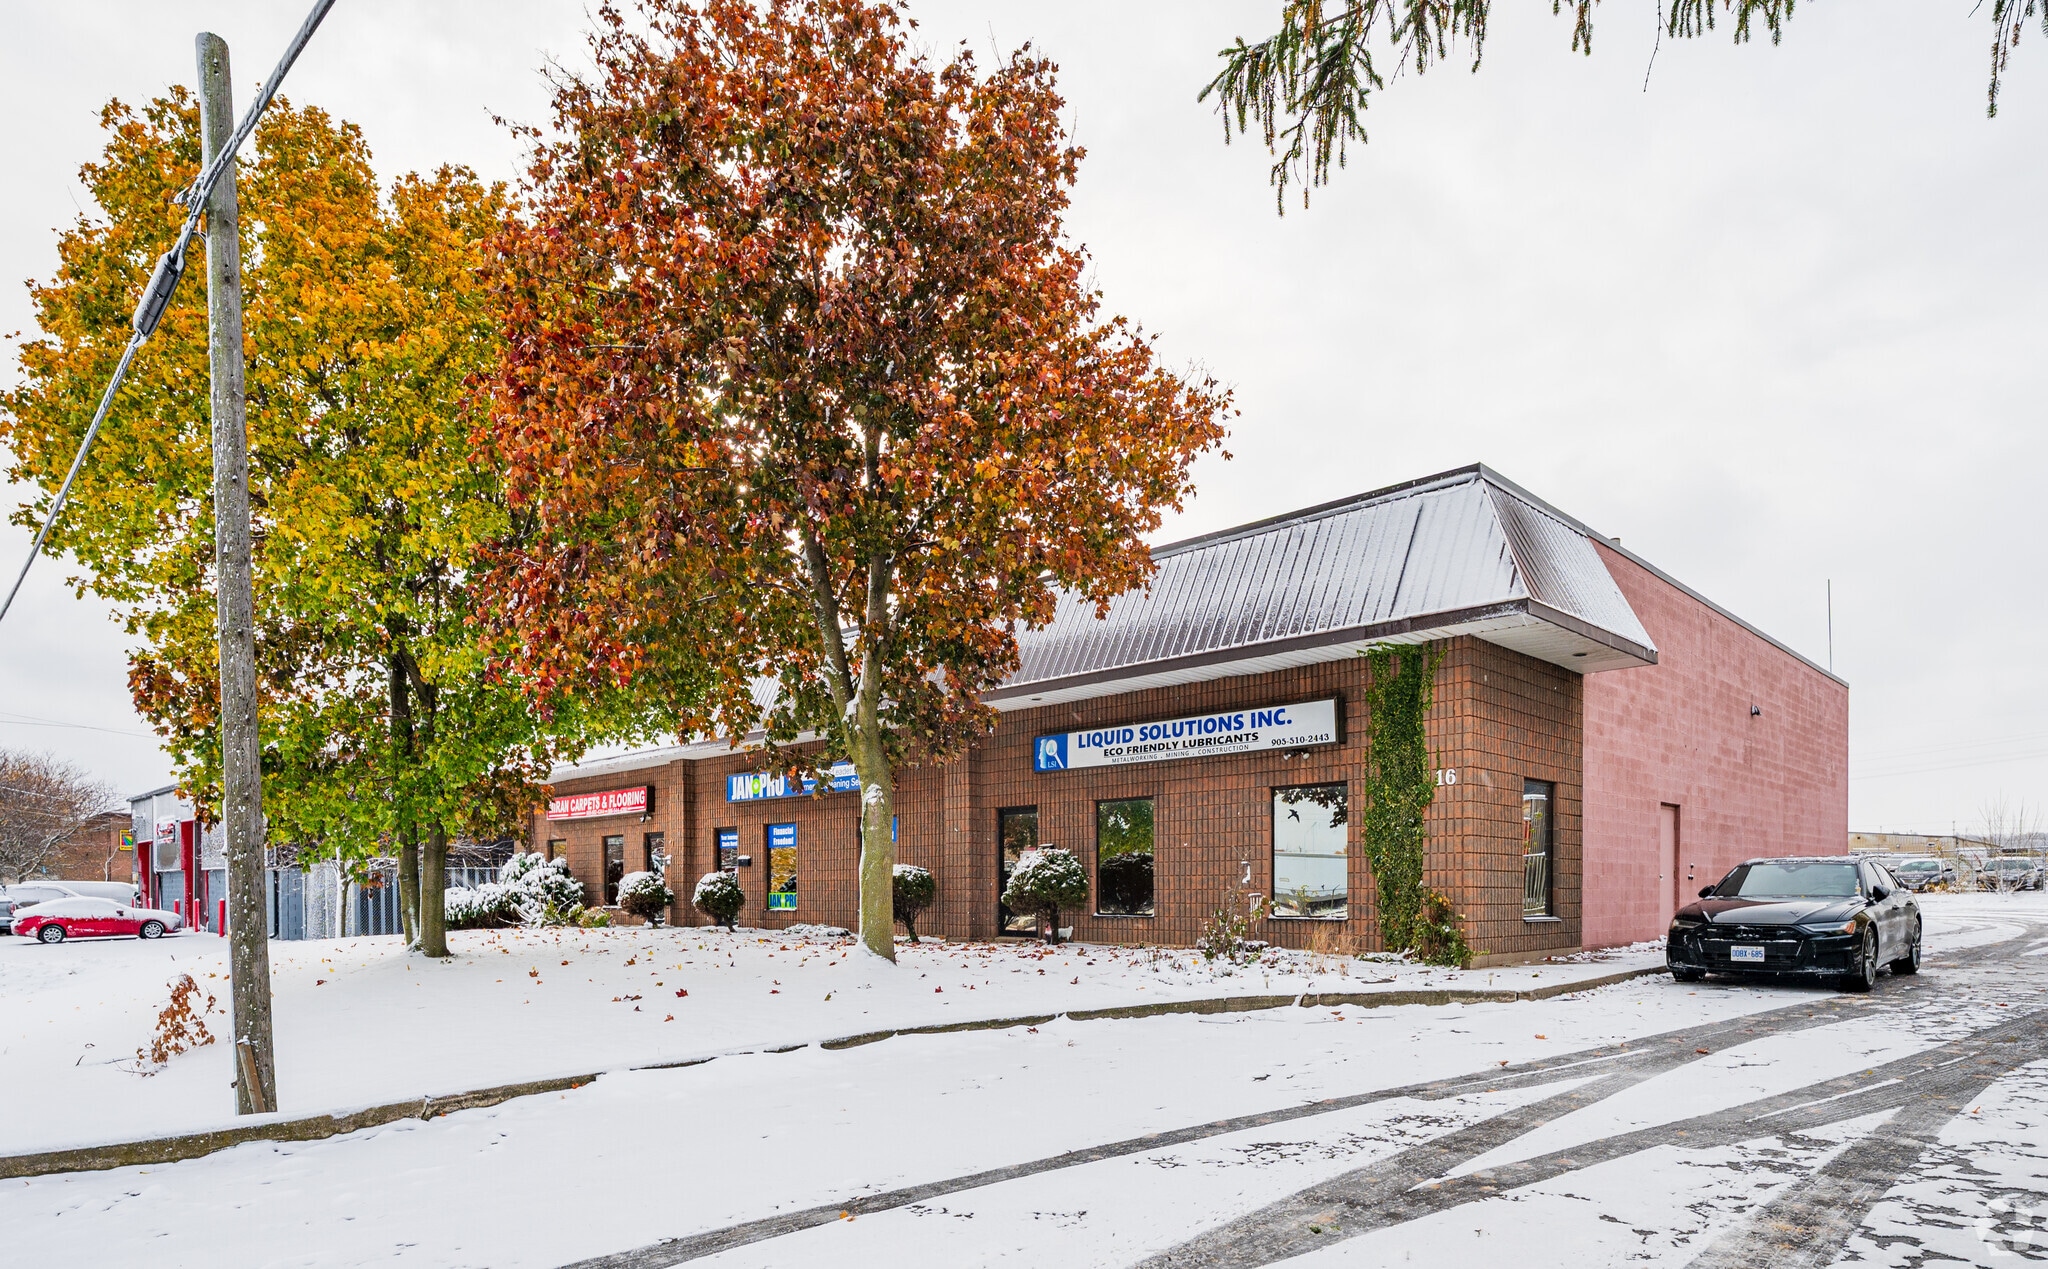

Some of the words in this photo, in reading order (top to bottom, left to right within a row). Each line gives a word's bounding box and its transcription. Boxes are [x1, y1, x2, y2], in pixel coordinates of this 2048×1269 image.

[1078, 728, 1134, 748] LIQUID
[1139, 714, 1244, 742] SOLUTIONS
[1250, 708, 1293, 729] INC.
[1103, 748, 1123, 757] ECO
[1127, 741, 1179, 755] FRIENDLY
[1182, 732, 1259, 748] LUBRICANTS
[1271, 733, 1330, 746] 905-510-2443
[1111, 754, 1158, 763] METALWORKING
[1197, 744, 1249, 755] CONSTRUCTION
[1435, 768, 1457, 786] 16
[570, 795, 600, 812] CARPETS
[601, 795, 608, 808] &
[609, 790, 645, 808] FLOORING
[773, 827, 794, 836] Financial
